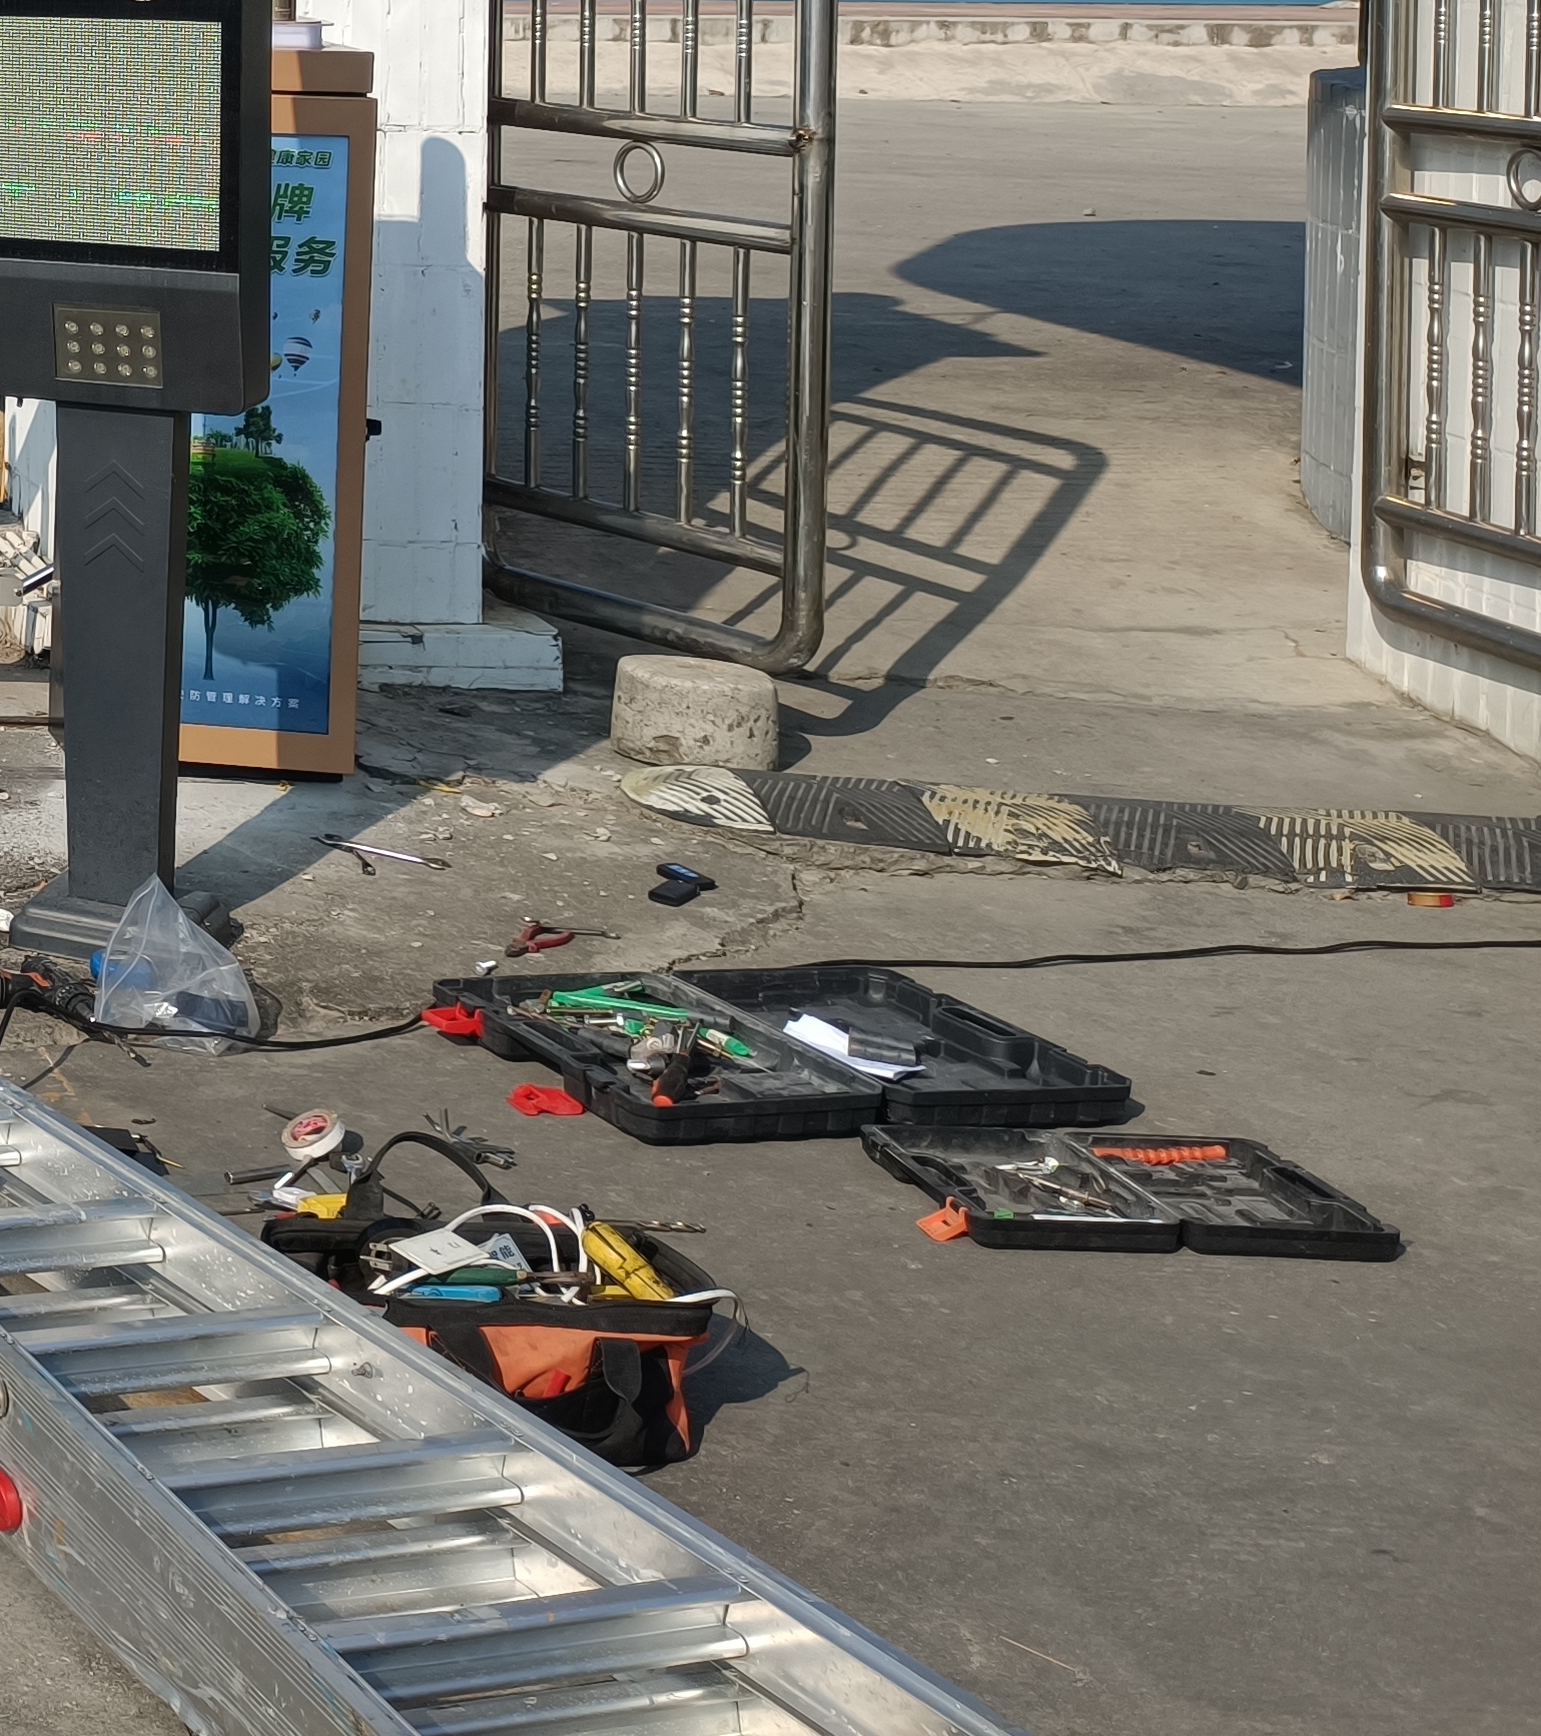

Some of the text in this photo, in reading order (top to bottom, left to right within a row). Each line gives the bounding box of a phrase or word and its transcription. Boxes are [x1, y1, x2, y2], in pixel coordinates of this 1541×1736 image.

[181, 689, 300, 709] 防管理解决方案
